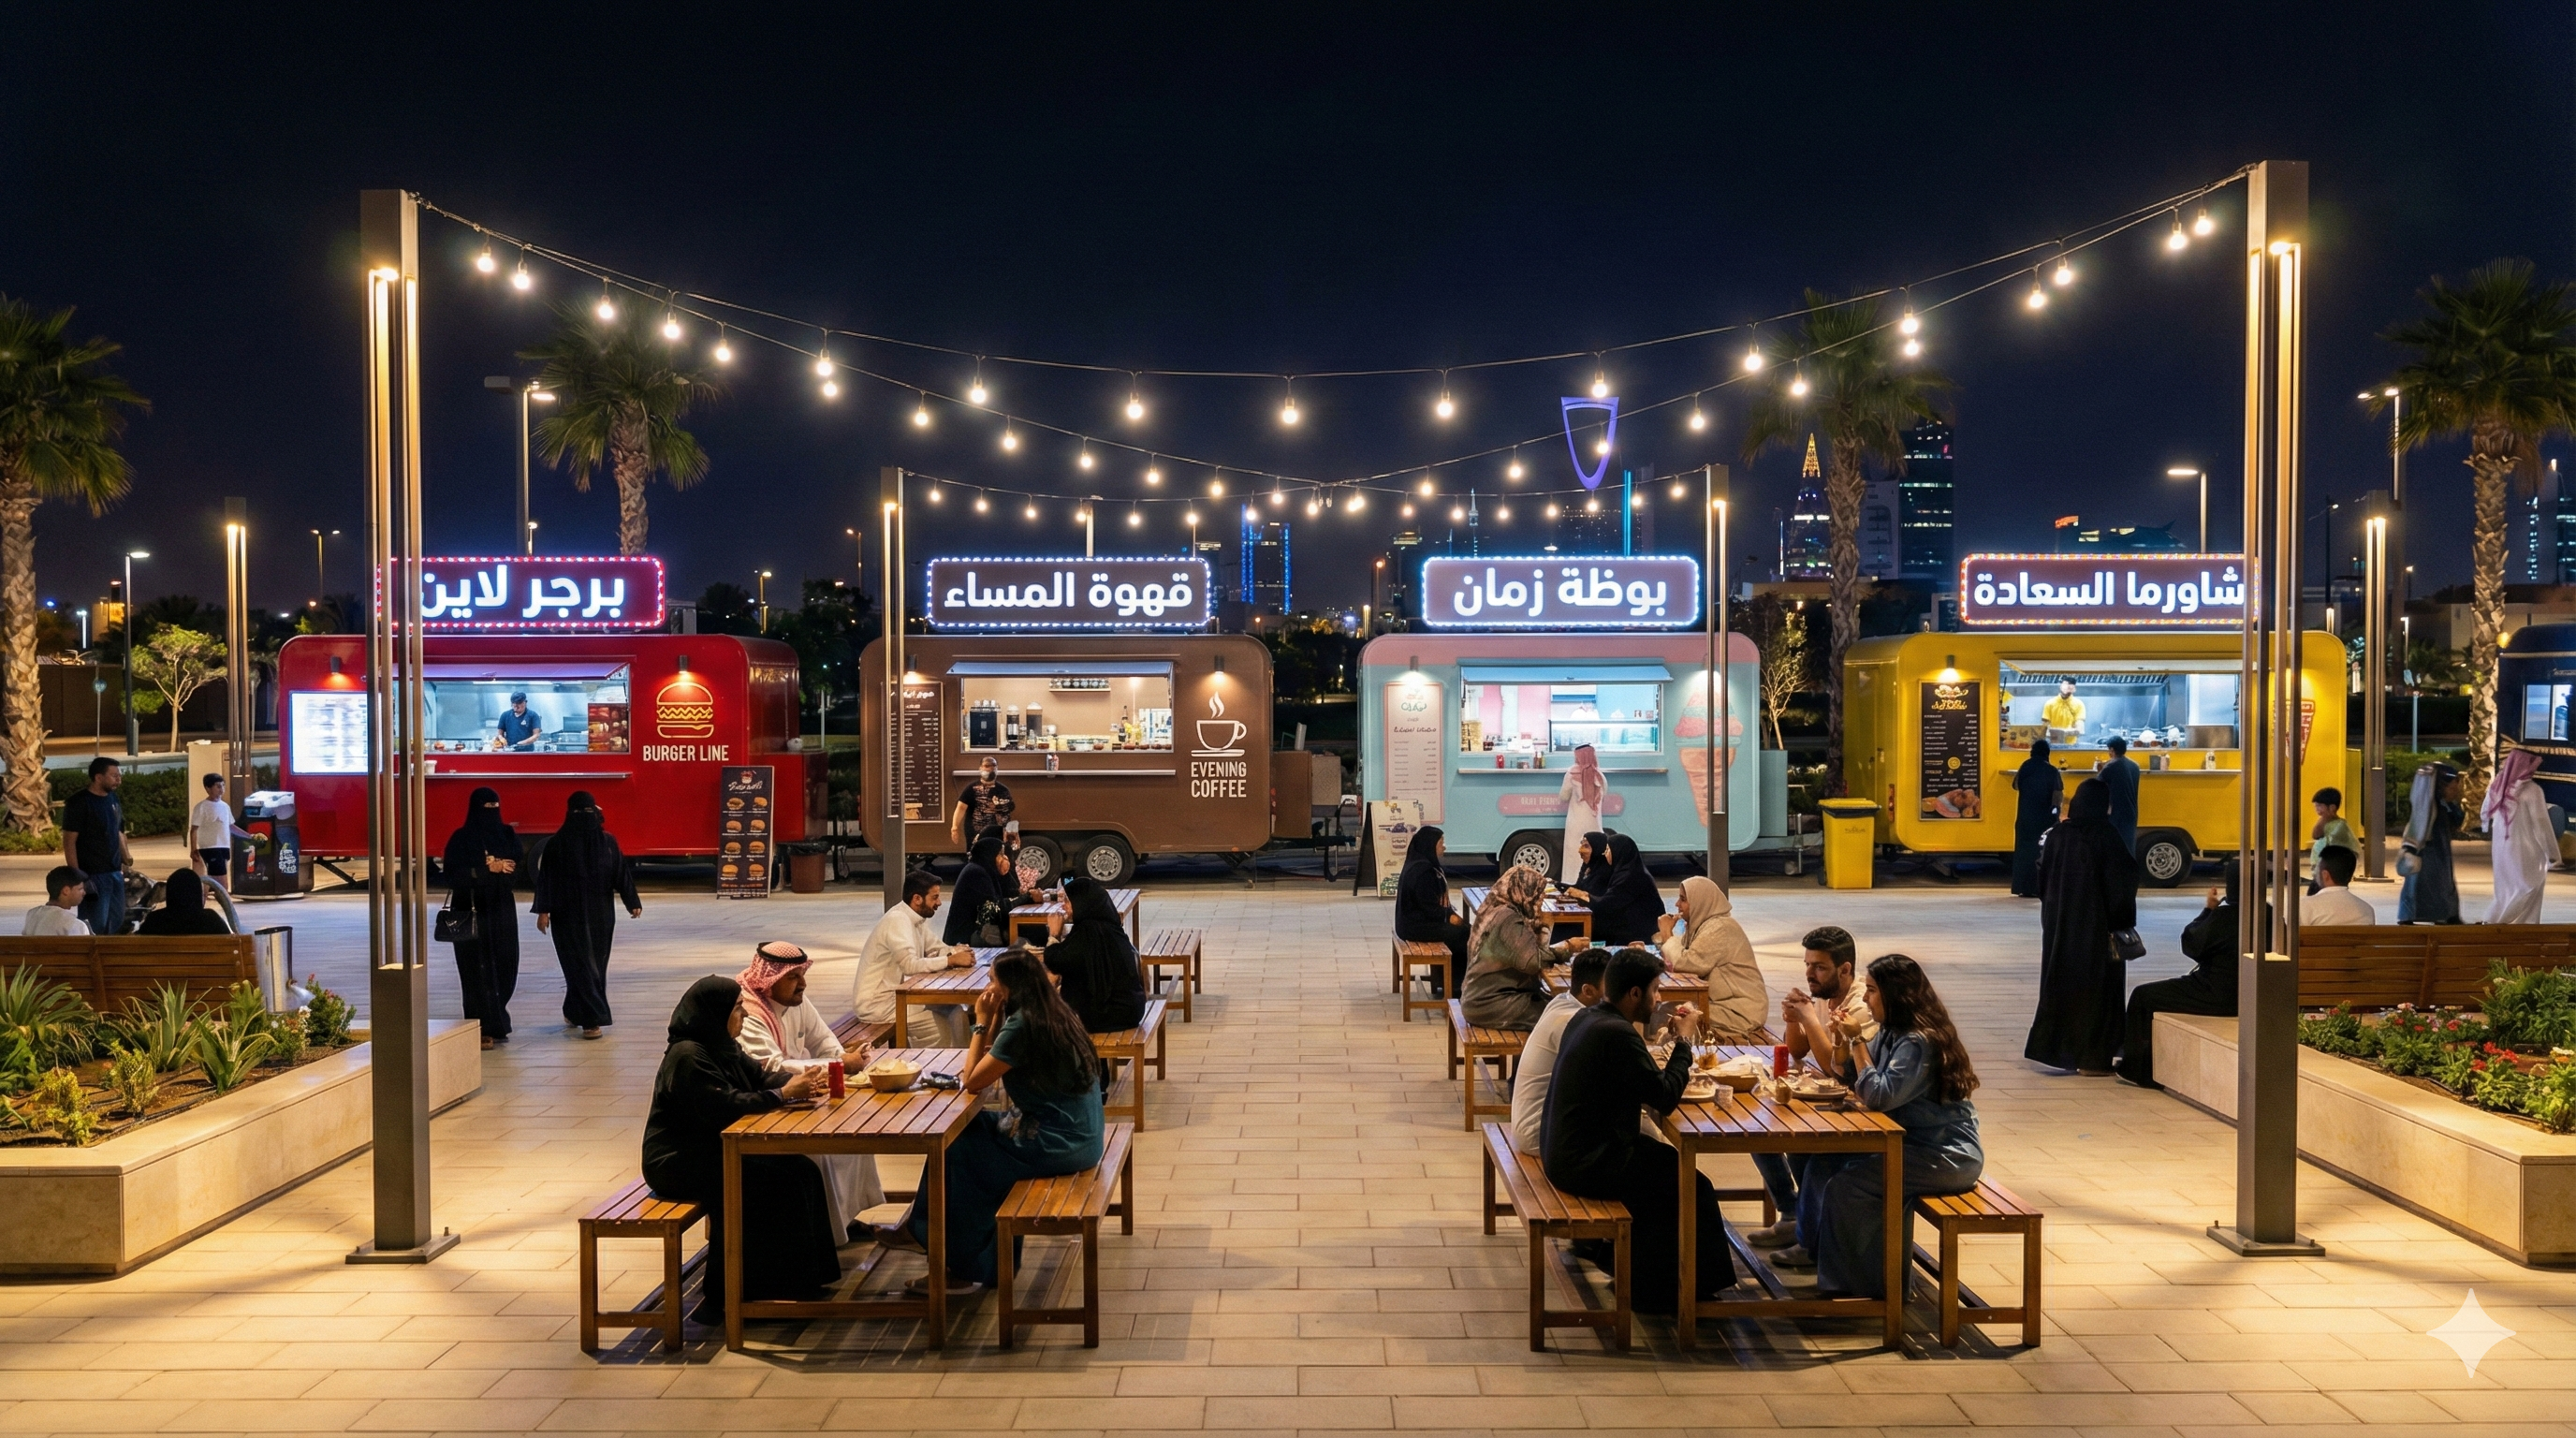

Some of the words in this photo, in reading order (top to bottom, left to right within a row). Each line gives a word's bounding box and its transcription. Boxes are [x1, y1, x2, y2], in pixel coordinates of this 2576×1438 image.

[422, 564, 508, 619] لاين
[522, 577, 625, 619] برجر
[944, 571, 1076, 609] المساء
[1087, 572, 1193, 617] قهوة
[1453, 566, 1545, 618] زمان
[1557, 566, 1668, 618] بوظة
[1973, 571, 2116, 607] السعادة
[2127, 565, 2245, 614] شاورما
[642, 744, 695, 762] BURGER
[699, 744, 729, 762] LINE
[1191, 761, 1247, 778] EVENING
[1191, 779, 1247, 798] COFFEE
